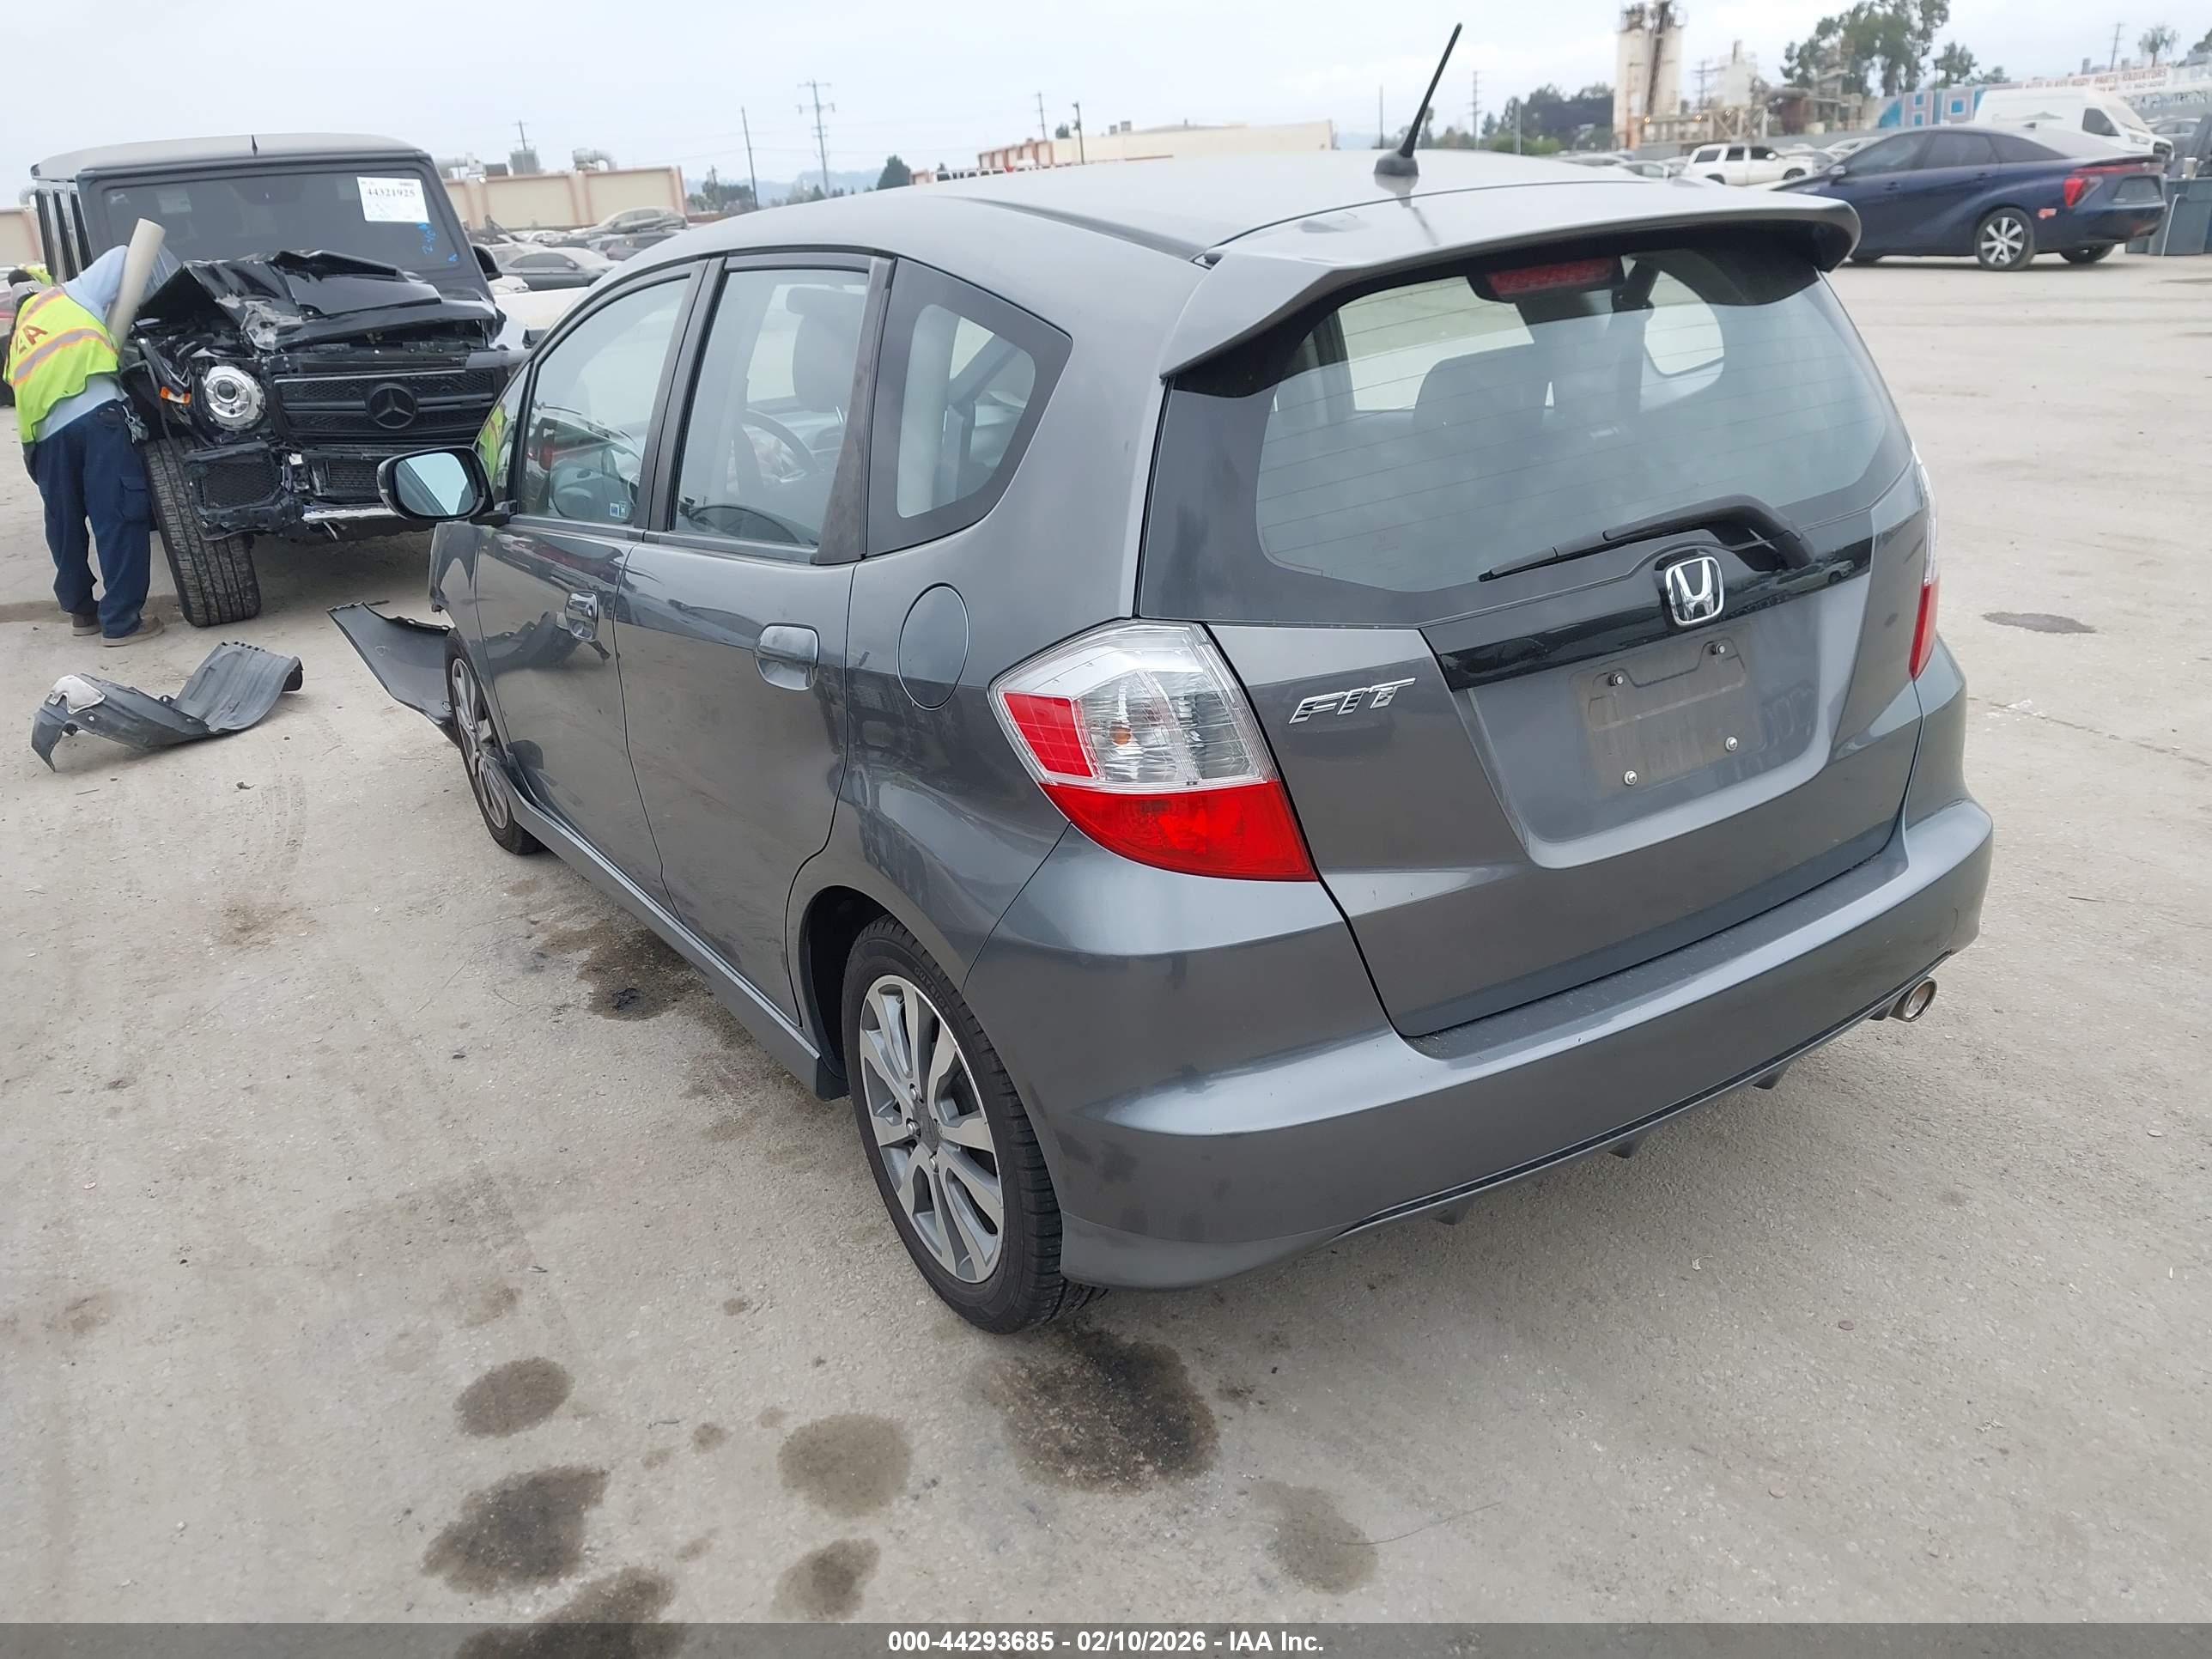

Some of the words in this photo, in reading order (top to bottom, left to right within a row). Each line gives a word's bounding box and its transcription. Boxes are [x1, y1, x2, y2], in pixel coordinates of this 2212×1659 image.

[2094, 74, 2117, 84] PARTS
[2123, 68, 2167, 82] RADIATORS
[367, 187, 416, 198] 44321925
[1288, 677, 1417, 726] FIT
